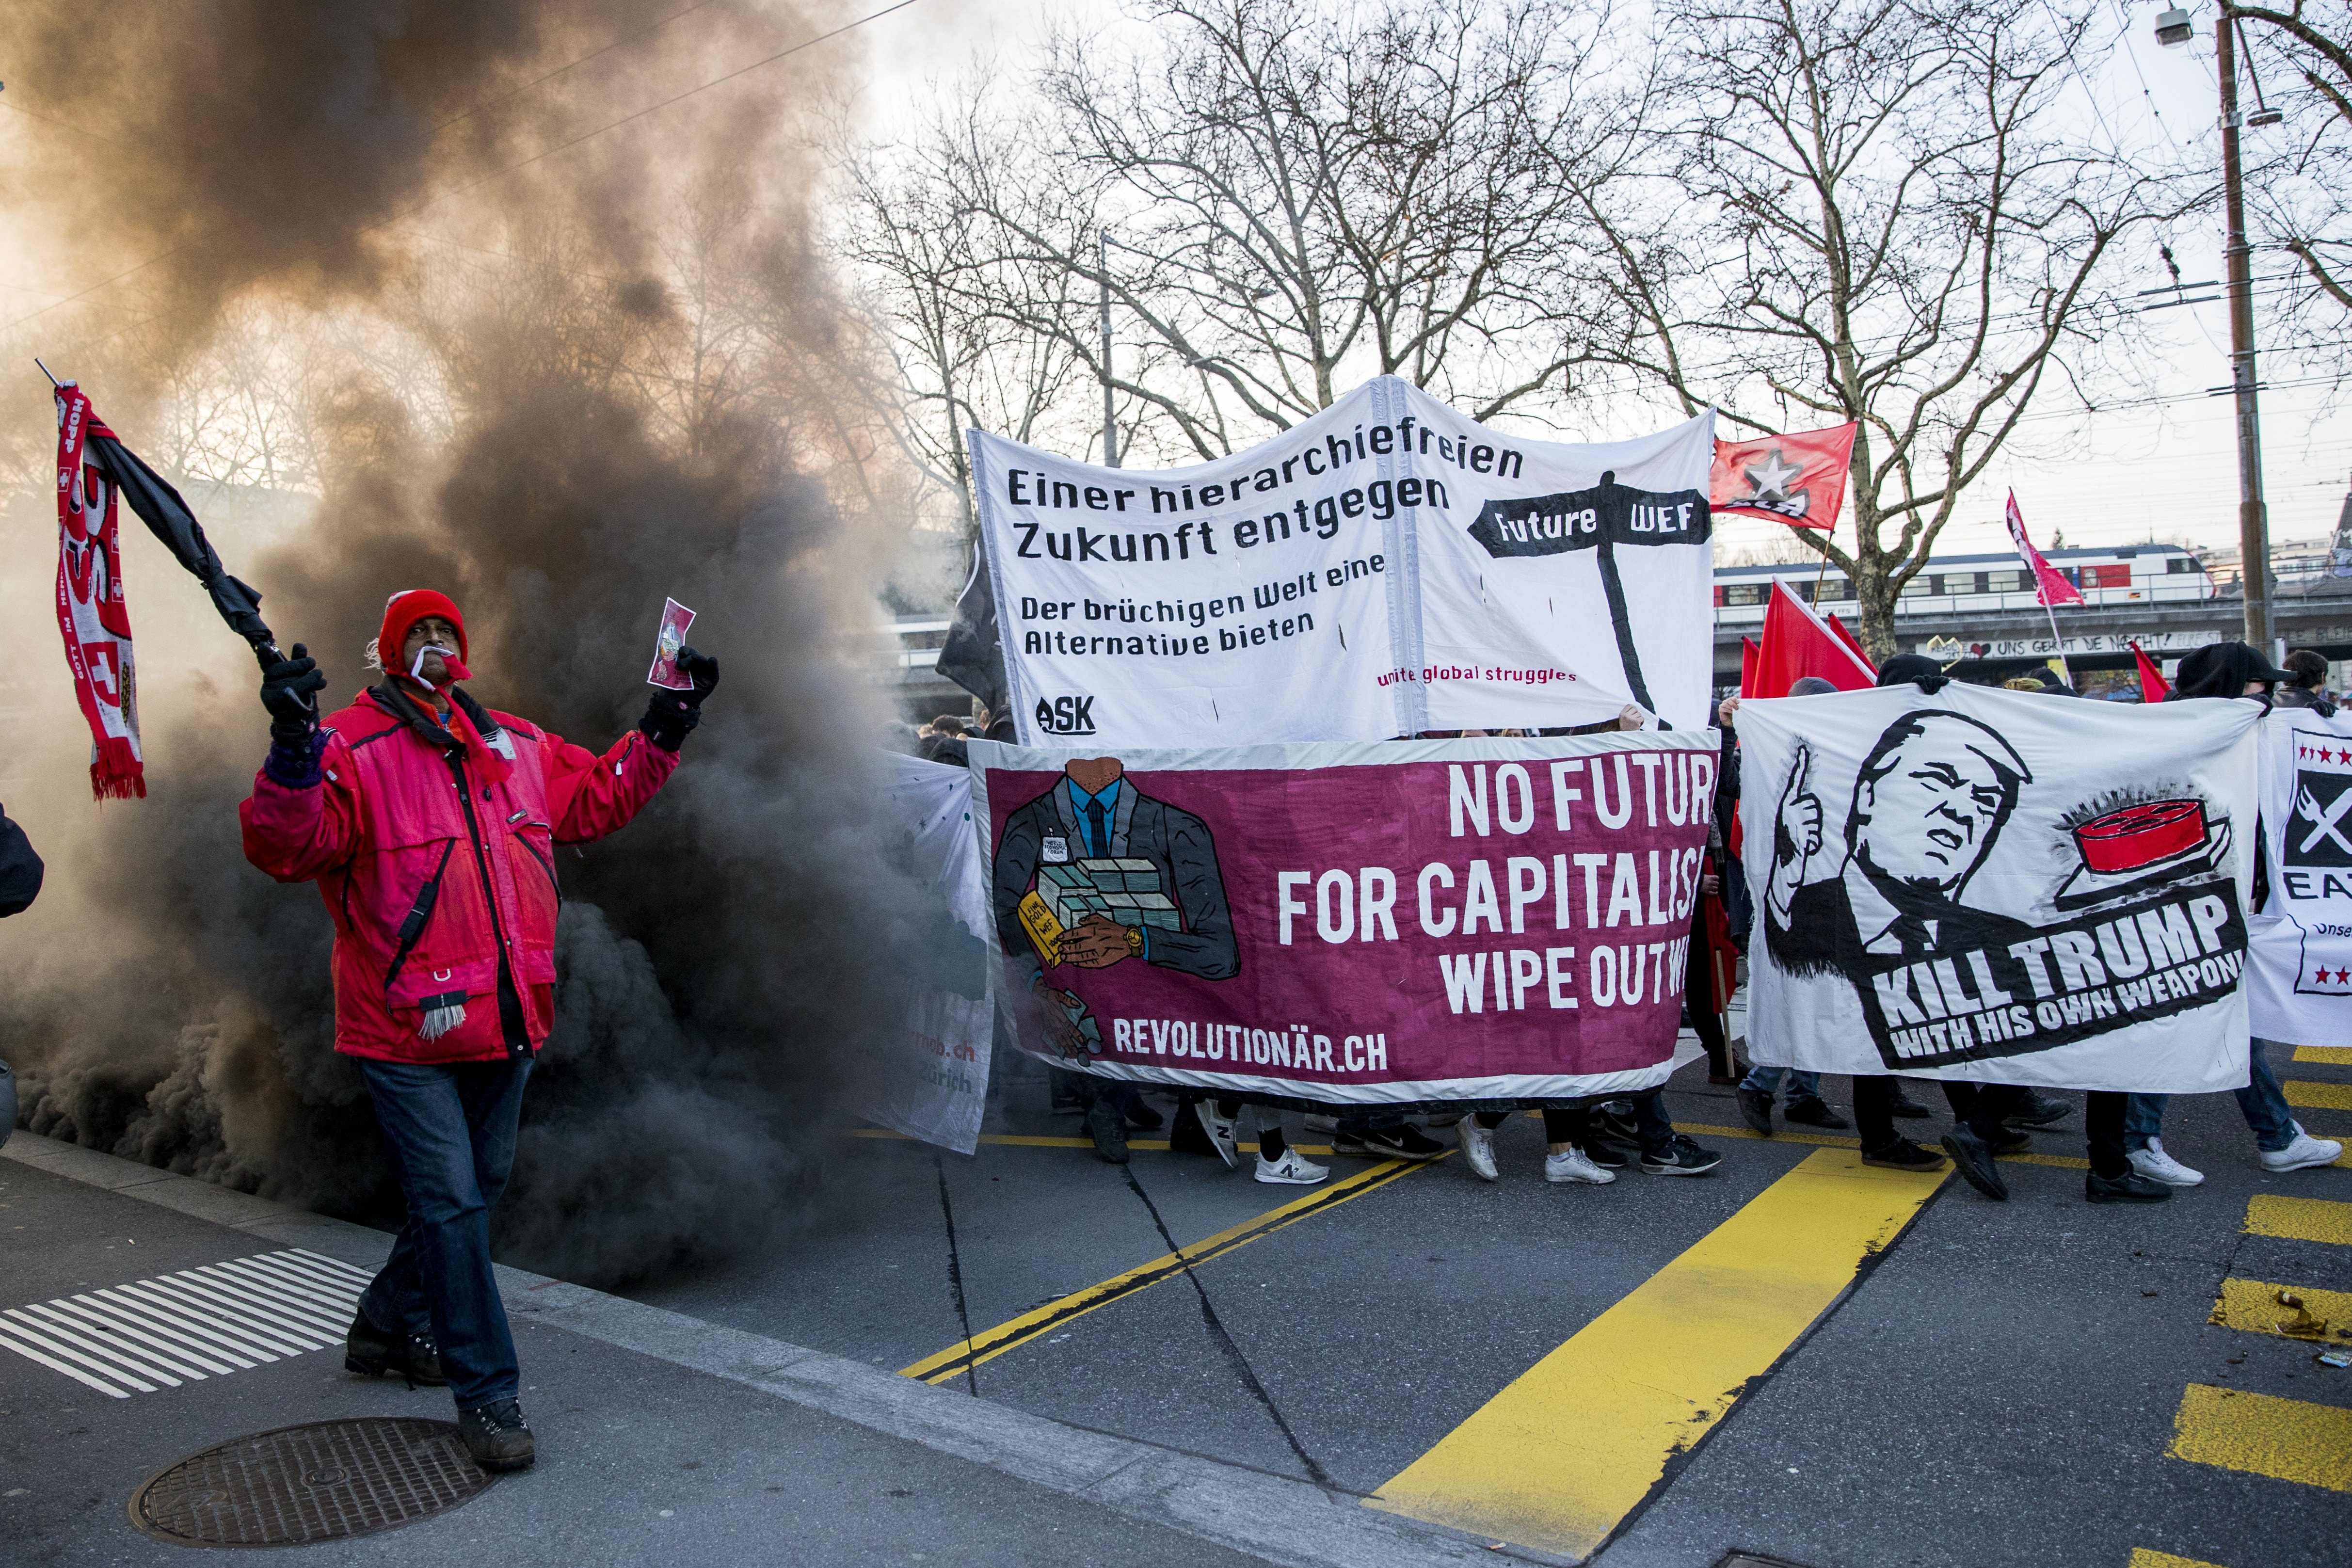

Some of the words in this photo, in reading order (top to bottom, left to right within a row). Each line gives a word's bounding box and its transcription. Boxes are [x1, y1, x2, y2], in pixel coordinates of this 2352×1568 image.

[65, 398, 84, 453] HOPP
[1008, 468, 1135, 512] Einer
[1151, 416, 1523, 513] hierarchiefreien
[1013, 522, 1217, 561] Zukunft
[1234, 477, 1450, 549] entgegen
[1495, 508, 1597, 542] Future
[1631, 502, 1694, 532] WEF
[1021, 597, 1075, 620] Der
[1084, 594, 1245, 627] brüchigen
[1253, 572, 1318, 609] Welt
[1327, 553, 1385, 586] eine
[1025, 630, 1210, 656] Alternative
[1221, 612, 1314, 652] bieten
[1998, 641, 2025, 655] UNS
[2083, 637, 2102, 651] DIE
[1377, 667, 1416, 687] unite
[1423, 665, 1478, 684] global
[1486, 667, 1577, 685] struggles
[1036, 696, 1096, 731] ASK
[1449, 763, 1534, 837] NO
[1550, 753, 1721, 832] FUTUR
[1027, 901, 1040, 914] FINE
[1278, 867, 1398, 945] FOR
[1417, 846, 1706, 938] CAPITALIS
[2283, 872, 2352, 900] EA
[1029, 906, 1046, 923] GOLD
[1039, 918, 1053, 935] WEF
[1439, 946, 1578, 1014] WIPE
[1872, 949, 2013, 1028] KILL
[2007, 895, 2229, 998] TRUMP
[1114, 1018, 1387, 1073] REVOLUTIONÄR.CH
[1889, 1014, 1974, 1058] WITH
[1977, 1005, 2035, 1043] HIS
[2036, 987, 2121, 1030] OWN
